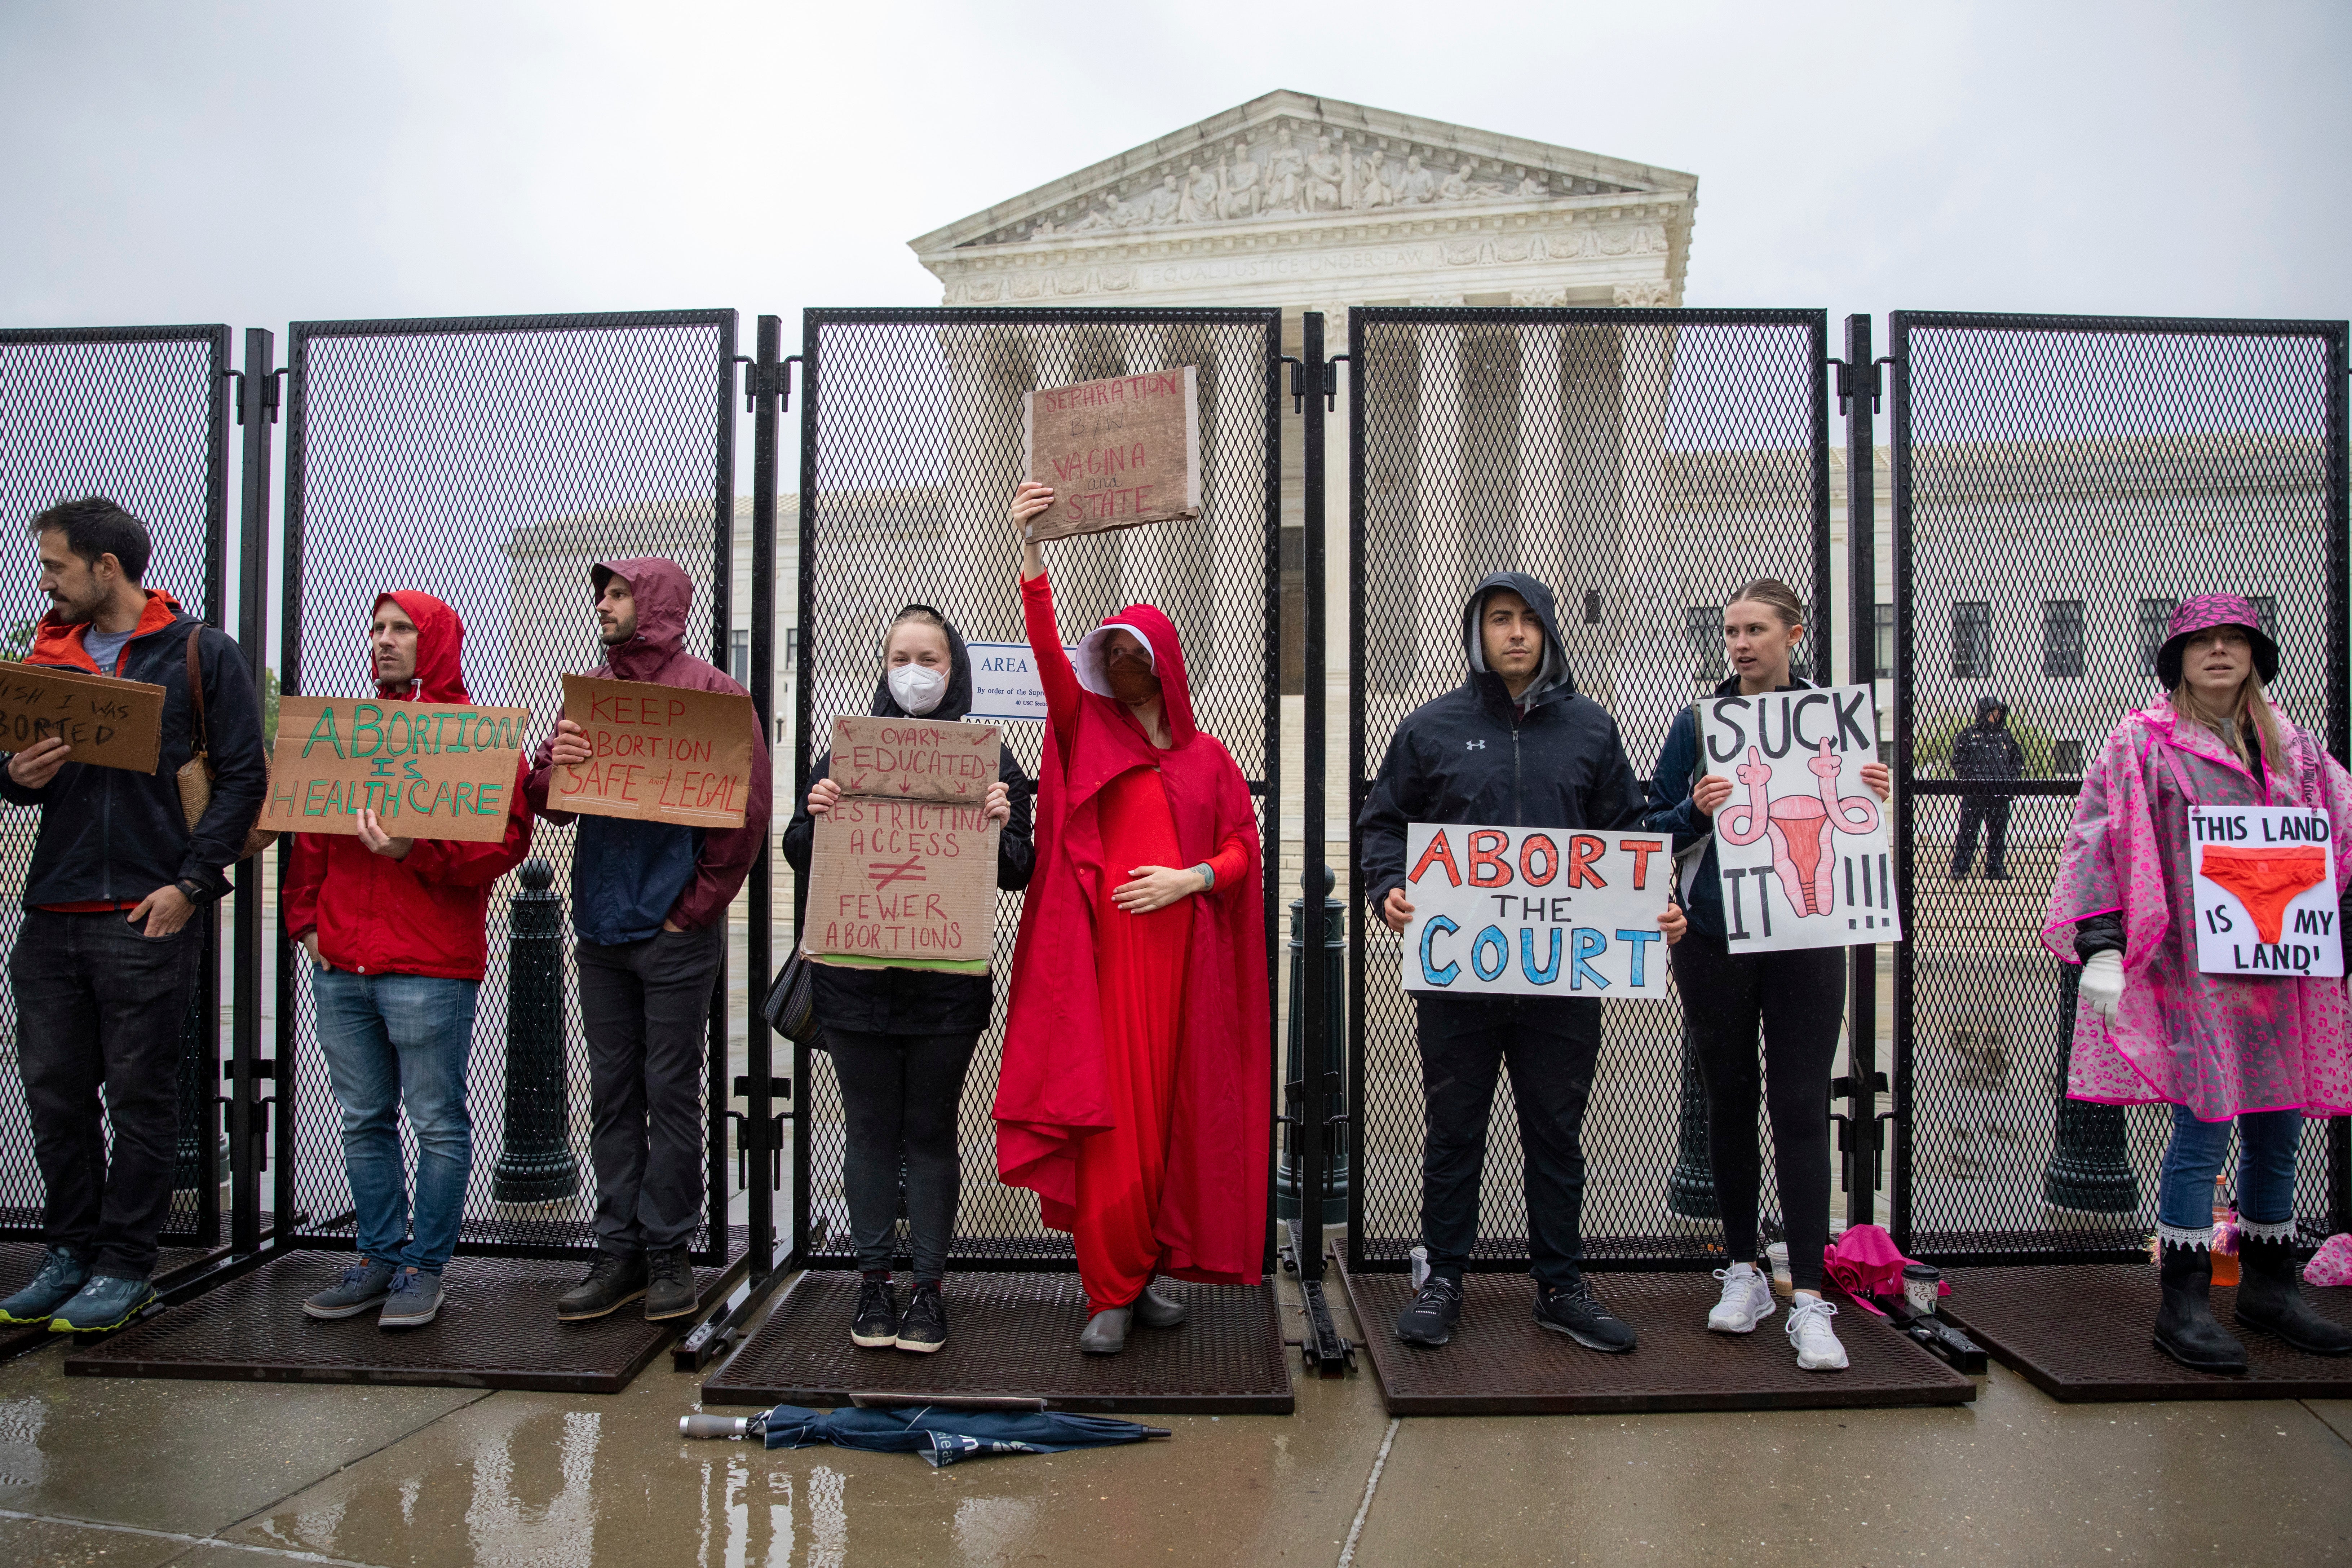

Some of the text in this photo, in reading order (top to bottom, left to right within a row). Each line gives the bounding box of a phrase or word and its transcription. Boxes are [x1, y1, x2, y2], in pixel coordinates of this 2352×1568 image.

[1153, 249, 1424, 283] EQUAL JUSTICE UNDER LAW
[1045, 372, 1176, 412] SEPARATION
[1052, 442, 1145, 482] VAGINA
[1088, 473, 1123, 490] and
[1067, 485, 1153, 520] STATE
[981, 657, 1028, 672] AREA
[0, 678, 129, 719] ISH I WAS
[591, 692, 685, 726] KEEP
[0, 710, 114, 745] BORTED
[301, 704, 525, 759] ABORTION
[1707, 691, 1871, 763] SUCK
[579, 729, 711, 762] ABORTION
[853, 746, 986, 779] EDUCATED
[371, 758, 423, 779] IS
[560, 761, 645, 801] SAFE
[659, 768, 743, 812] LEGAL
[850, 828, 959, 857] ACCESS
[2192, 816, 2329, 842] THIS LAND
[1407, 828, 1663, 890] ABORT
[839, 893, 948, 922] FEWER
[1490, 895, 1572, 923] THE
[1723, 865, 1775, 941] IT
[2205, 904, 2334, 936] IS MY
[826, 921, 962, 950] ABORTIONS
[1419, 915, 1661, 991] COURT
[2233, 943, 2320, 976] LAND!
